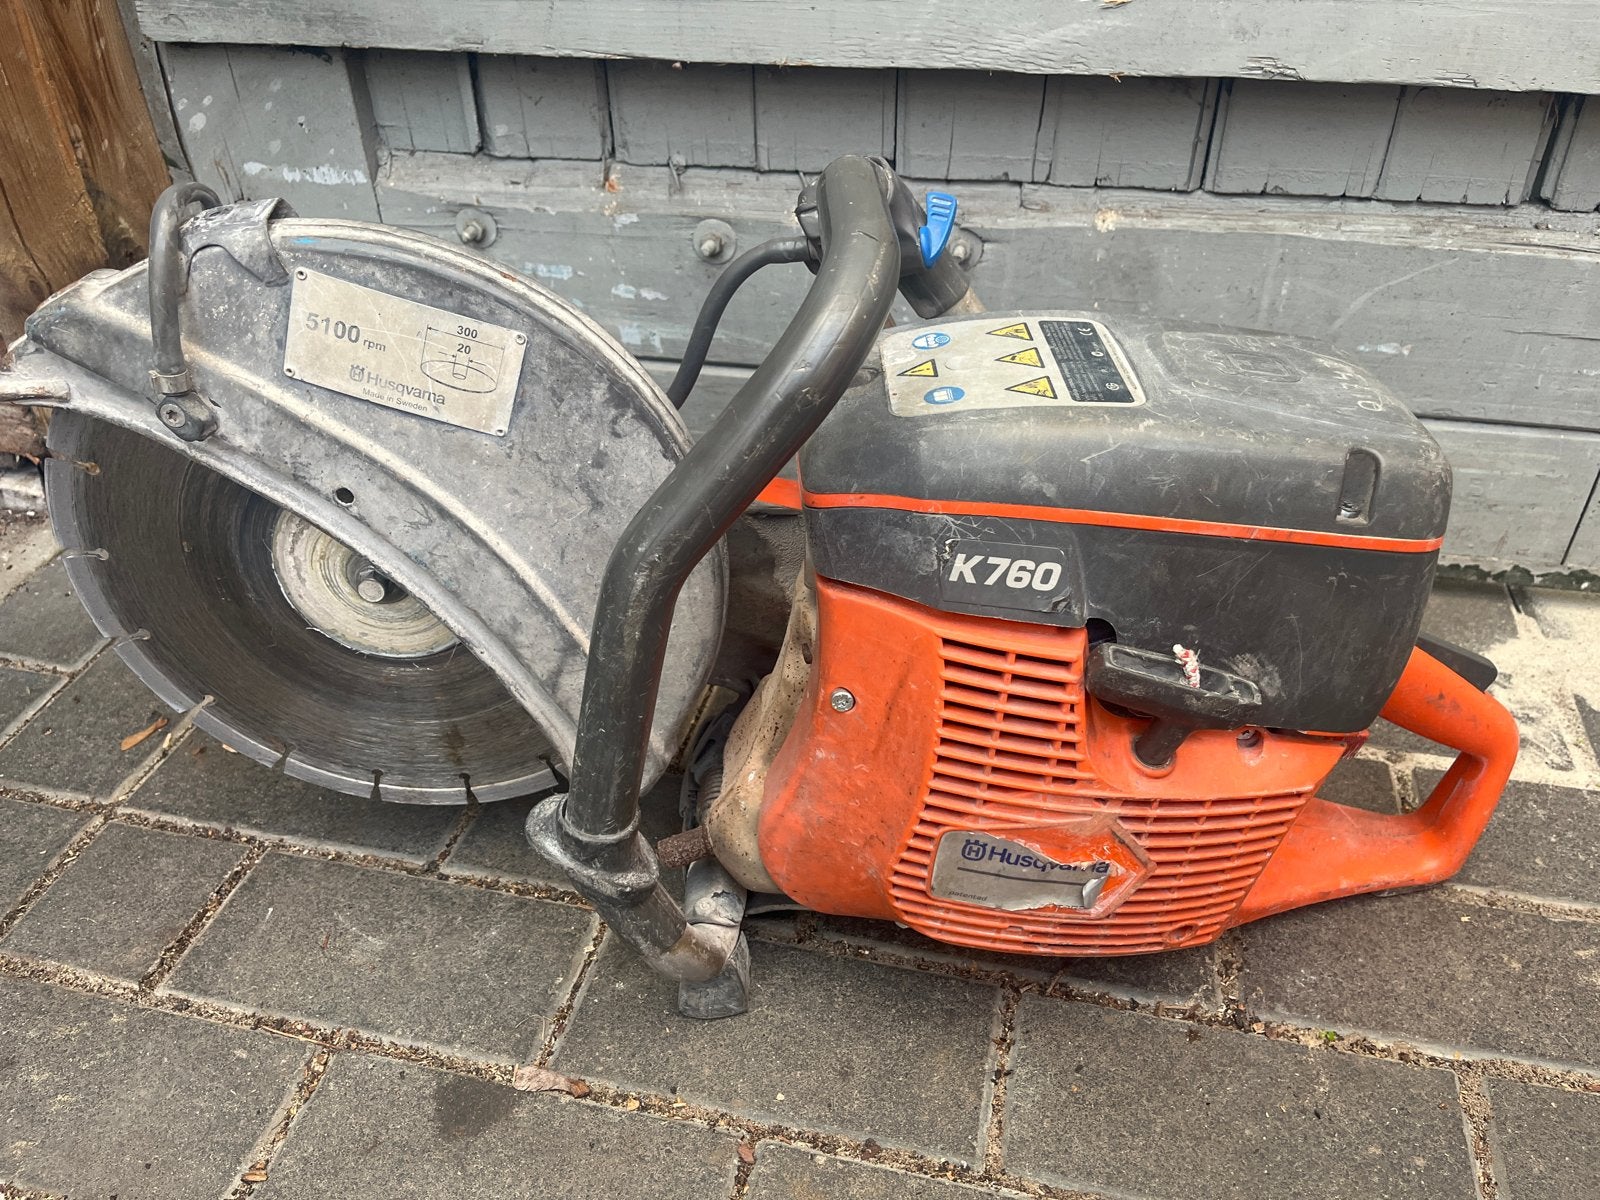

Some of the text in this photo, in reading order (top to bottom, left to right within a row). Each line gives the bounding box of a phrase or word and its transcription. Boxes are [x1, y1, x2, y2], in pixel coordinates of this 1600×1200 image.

[305, 312, 387, 353] 5100 rpm
[456, 325, 478, 339] 300
[457, 343, 472, 355] 20
[362, 387, 428, 412] Made in Sweden
[366, 372, 446, 405] Husqvarna
[988, 845, 1110, 874] Husqvaa
[948, 890, 988, 902] patented
